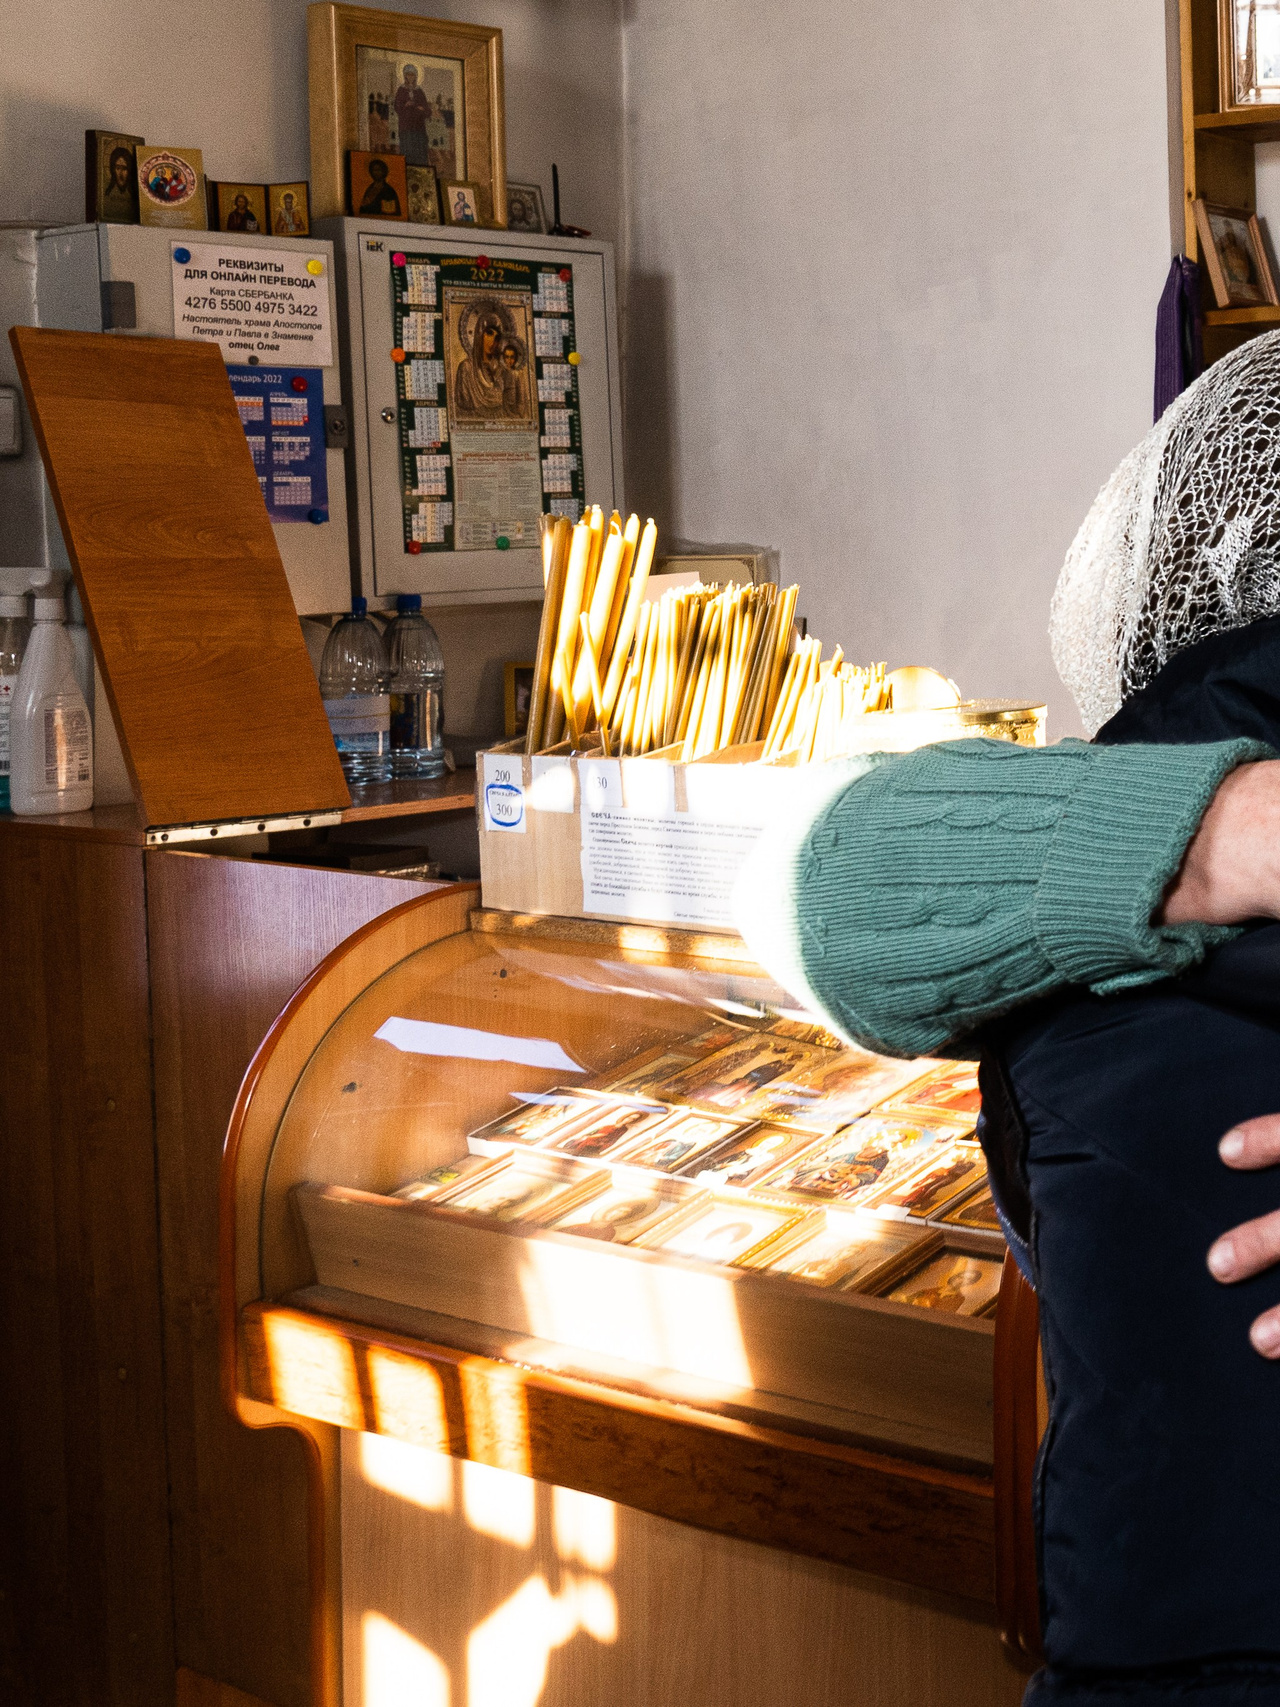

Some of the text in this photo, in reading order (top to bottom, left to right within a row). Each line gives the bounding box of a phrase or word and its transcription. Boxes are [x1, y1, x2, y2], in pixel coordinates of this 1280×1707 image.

[218, 258, 284, 273] РЕКВИЗИТЫ
[184, 268, 317, 289] ДЛЯ ОНЛАЙН ПЕРЕВОДА
[470, 267, 504, 282] 2022
[209, 286, 295, 301] Карта СБЕРБАНКА
[184, 296, 318, 317] 4276 5500 4975 3422
[182, 313, 322, 331] Настоятель храма Апостолов
[192, 325, 223, 338] Петра
[234, 328, 262, 339] Павла
[271, 331, 314, 341] Знаменке
[228, 341, 280, 352] отец Олег
[229, 374, 283, 384] лендарь 2022
[495, 769, 511, 783] 200
[496, 803, 512, 816] 300
